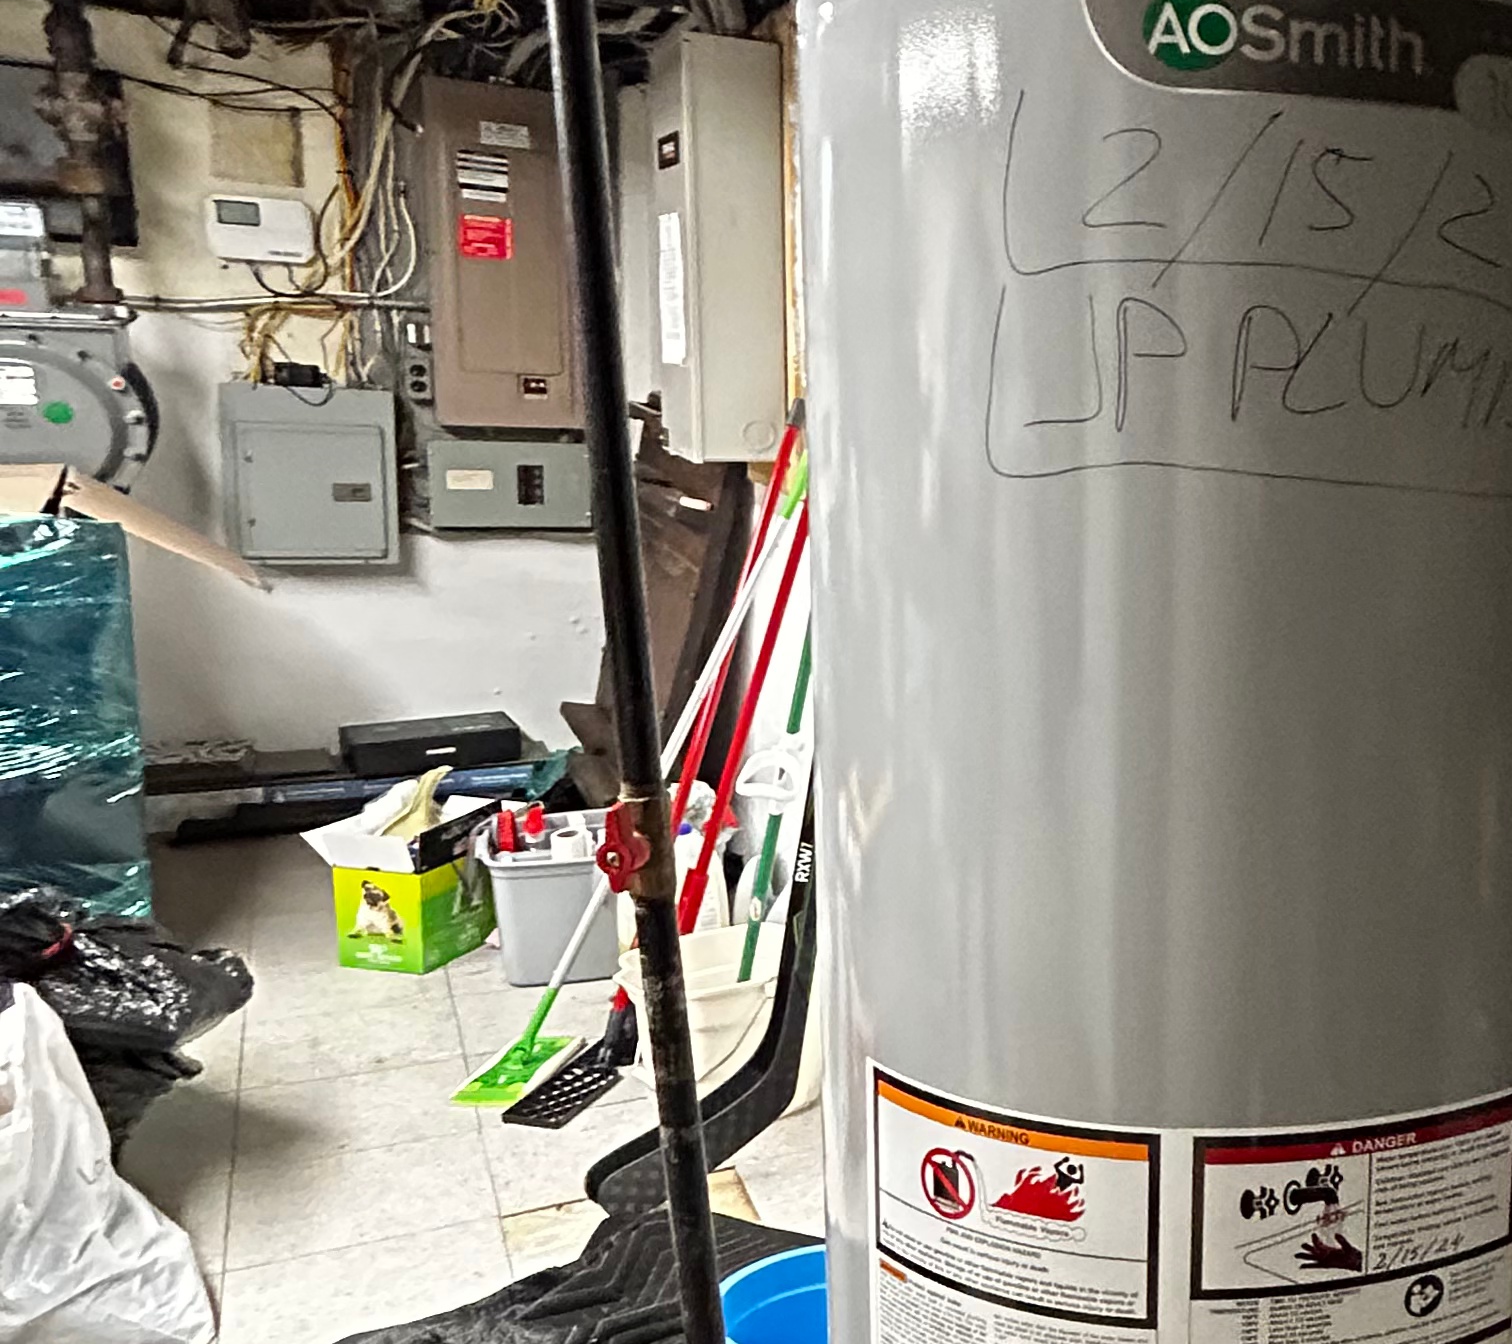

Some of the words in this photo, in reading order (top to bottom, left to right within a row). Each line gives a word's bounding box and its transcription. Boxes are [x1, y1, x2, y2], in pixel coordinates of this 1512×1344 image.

[967, 1119, 1030, 1146] WARNING
[1352, 1131, 1417, 1154] DANGER
[1373, 1233, 1465, 1271] 2/15/24
